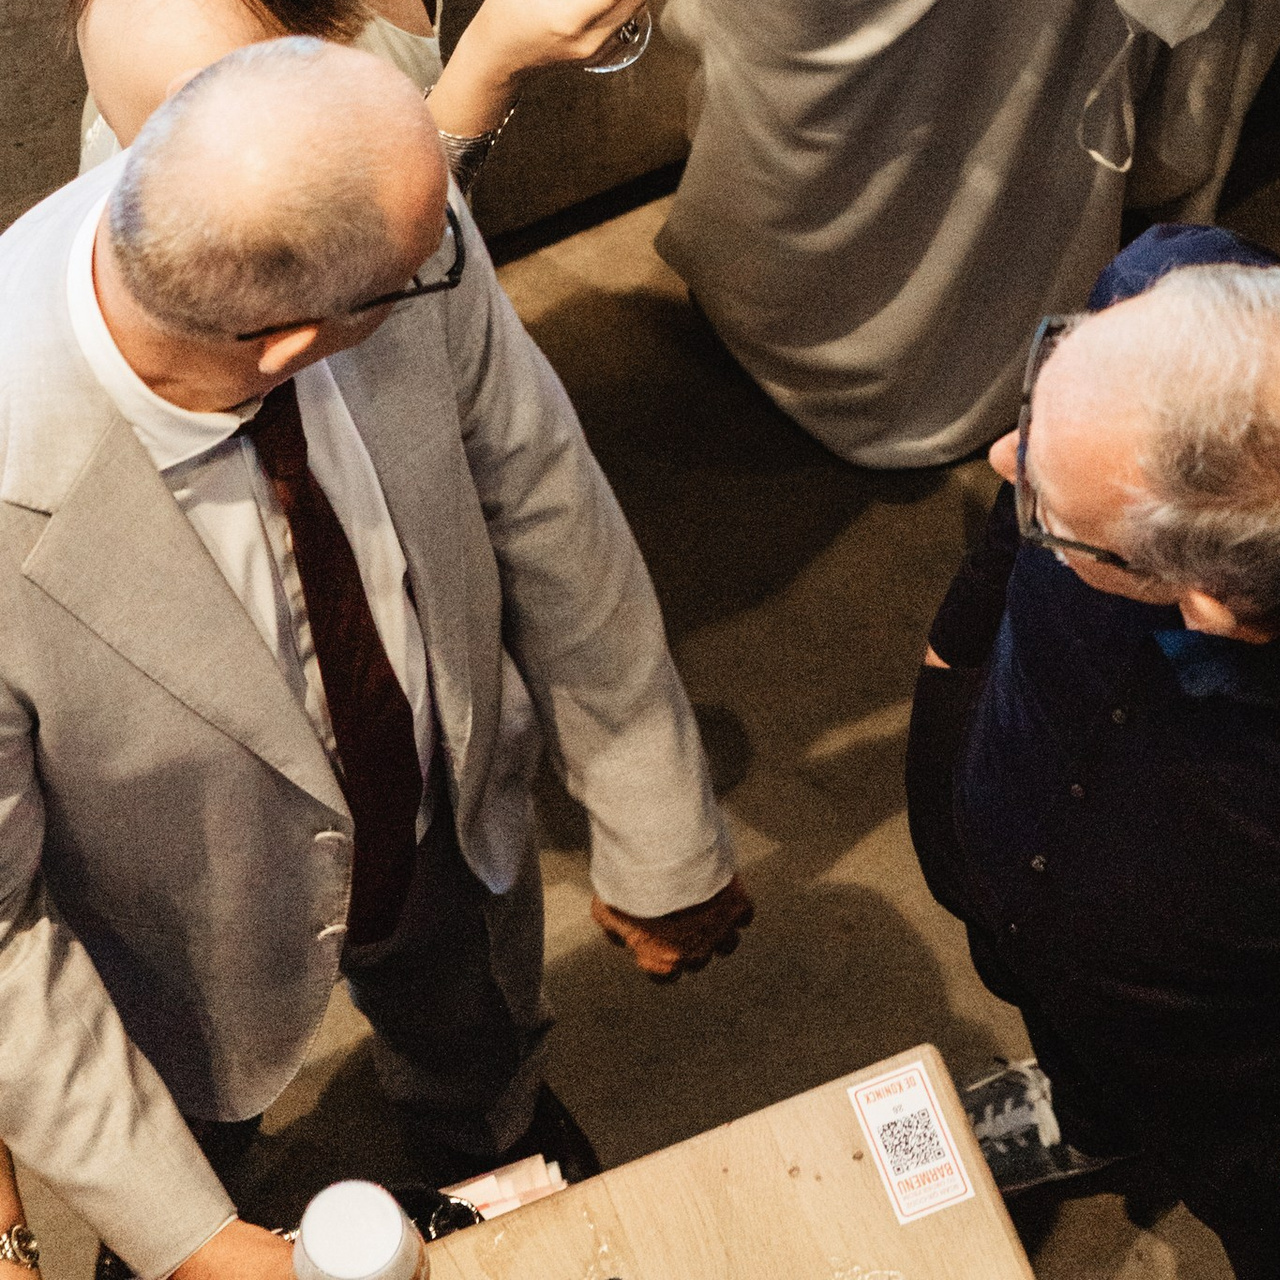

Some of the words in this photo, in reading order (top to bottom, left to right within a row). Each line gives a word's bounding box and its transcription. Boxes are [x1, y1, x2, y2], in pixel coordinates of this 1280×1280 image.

[864, 1082, 904, 1104] KONINCK
[905, 1075, 916, 1090] DE
[897, 1162, 954, 1195] BARMENU
